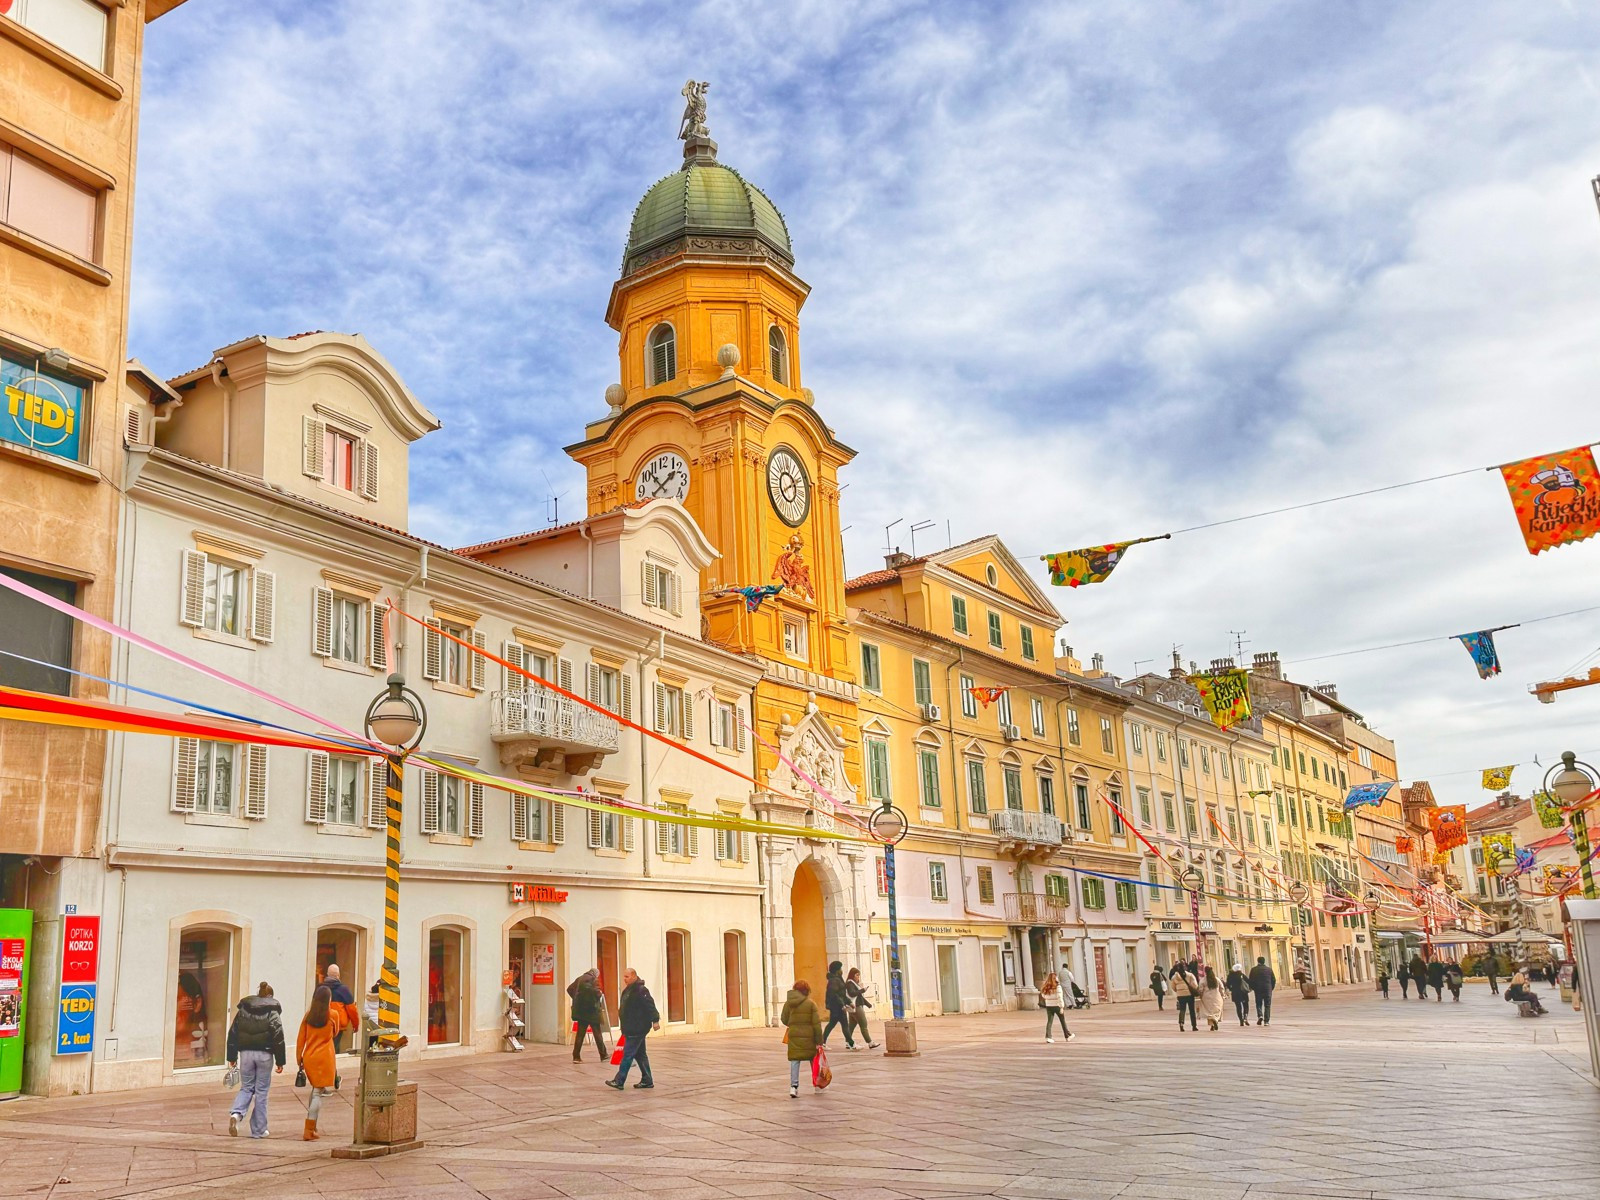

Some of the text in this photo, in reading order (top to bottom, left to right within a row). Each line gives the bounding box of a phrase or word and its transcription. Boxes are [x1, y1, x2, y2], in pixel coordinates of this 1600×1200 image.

[5, 386, 75, 435] TEDi
[650, 461, 657, 474] 11
[659, 456, 668, 469] 12
[671, 456, 675, 469] 1
[676, 461, 682, 474] 2
[642, 470, 651, 483] 10
[680, 473, 687, 486] 3
[638, 485, 645, 497] 9
[676, 487, 683, 499] 4
[70, 928, 94, 939] OPTIKA
[69, 940, 94, 951] KORZO
[61, 998, 95, 1013] TEDi
[61, 1031, 91, 1045] 2. kat
